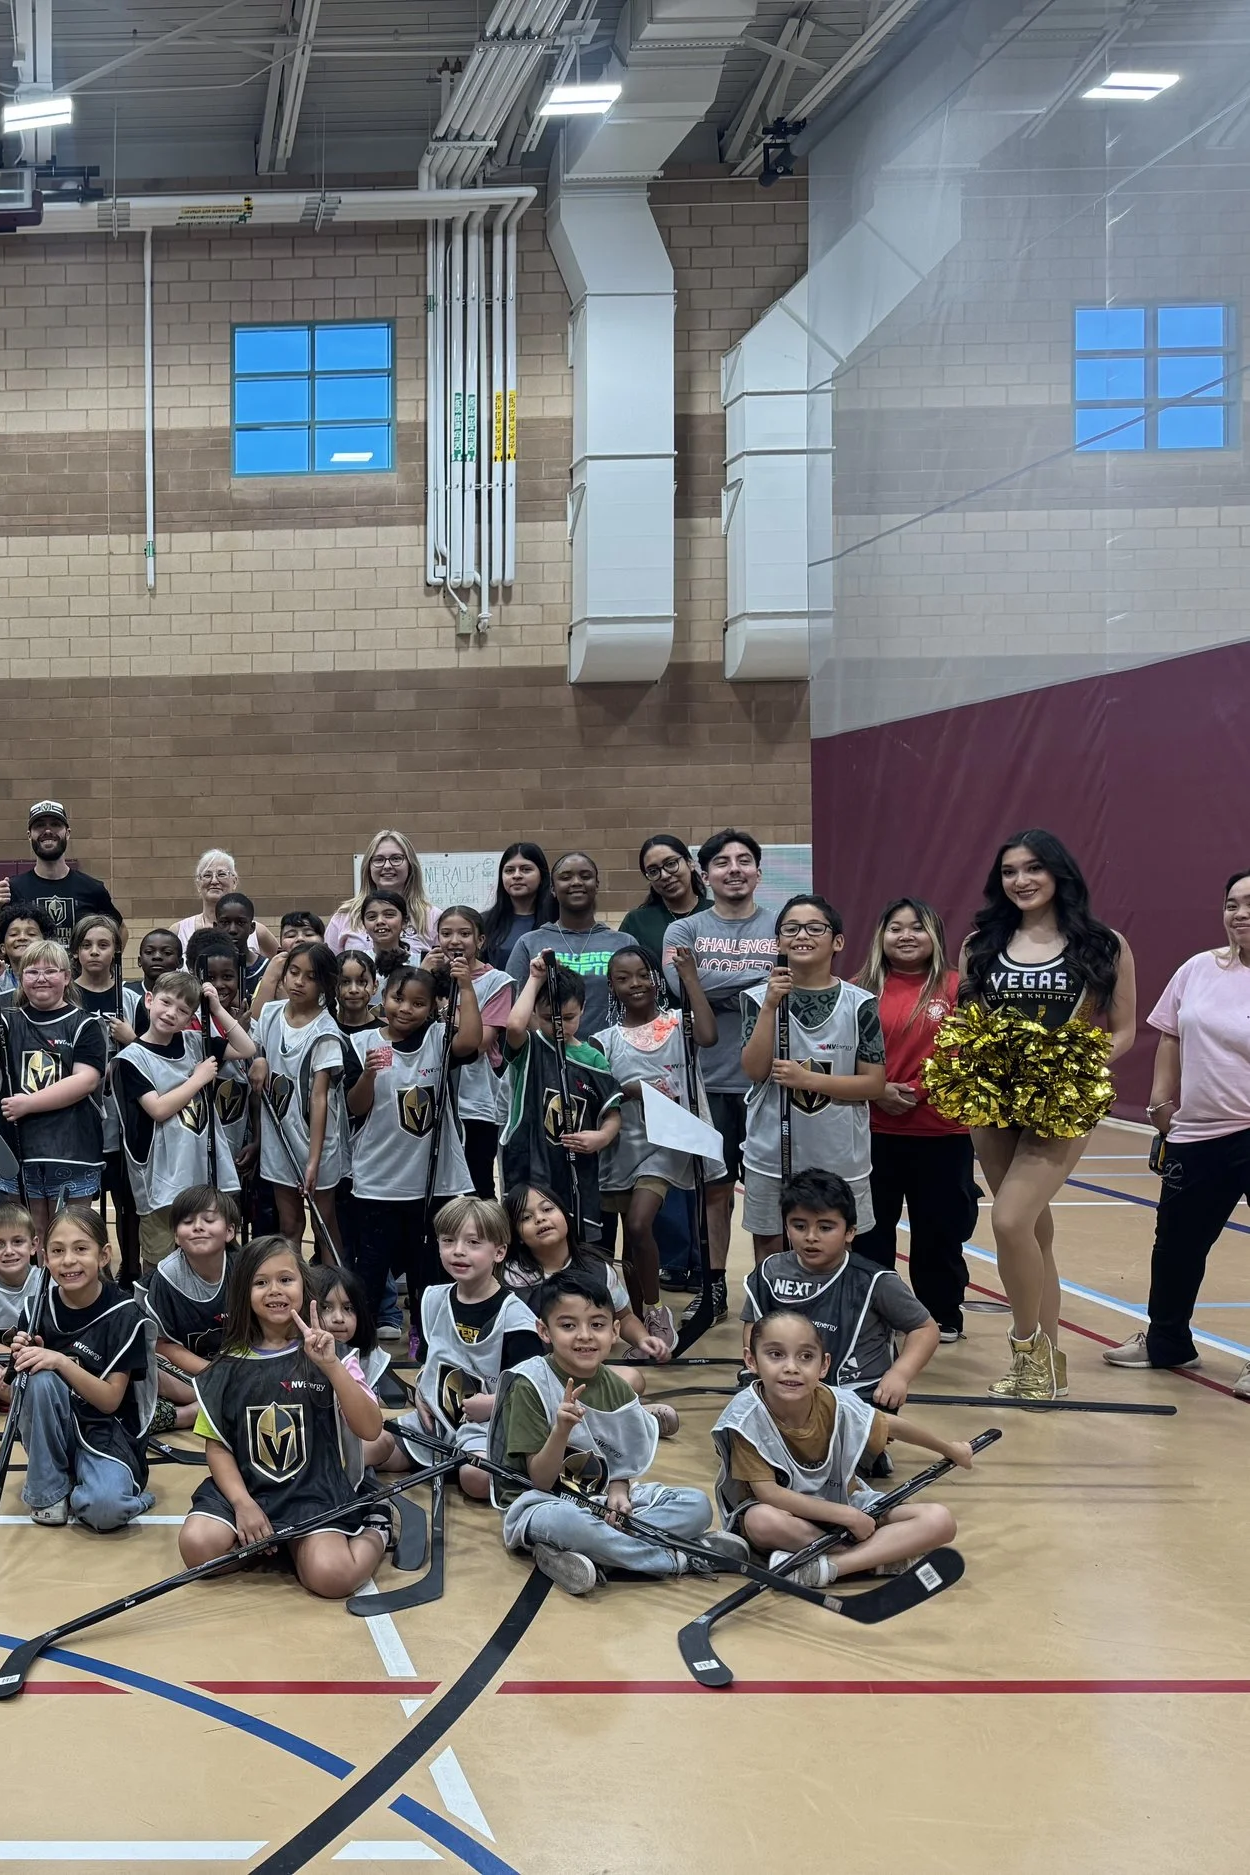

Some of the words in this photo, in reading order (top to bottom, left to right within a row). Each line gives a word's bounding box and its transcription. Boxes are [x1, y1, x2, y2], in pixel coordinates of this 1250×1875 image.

[425, 866, 475, 883] MERALD
[695, 937, 779, 955] CHALLENGE
[991, 972, 1067, 992] VEGAS
[987, 992, 1022, 1002] GOLDEN
[1028, 993, 1074, 1003] KNIGHTS
[774, 1278, 812, 1297] NEXT
[813, 1321, 837, 1332] Energy
[73, 1341, 102, 1361] NVEnergy
